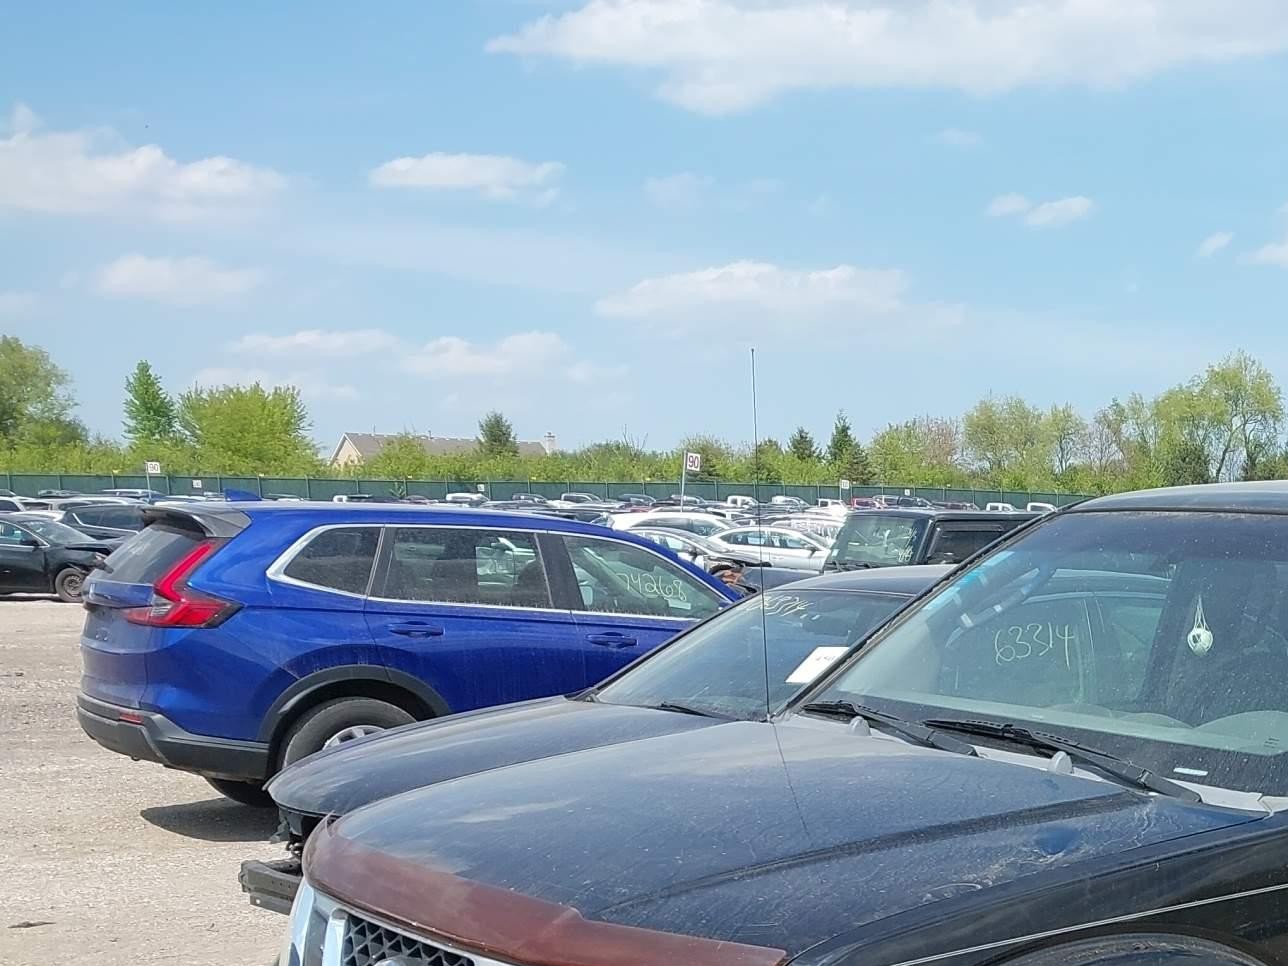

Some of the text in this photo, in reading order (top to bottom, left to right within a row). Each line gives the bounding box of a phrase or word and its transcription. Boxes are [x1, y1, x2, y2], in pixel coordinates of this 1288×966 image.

[688, 455, 699, 469] 90
[616, 573, 687, 602] 74268
[994, 621, 1076, 671] 63314
